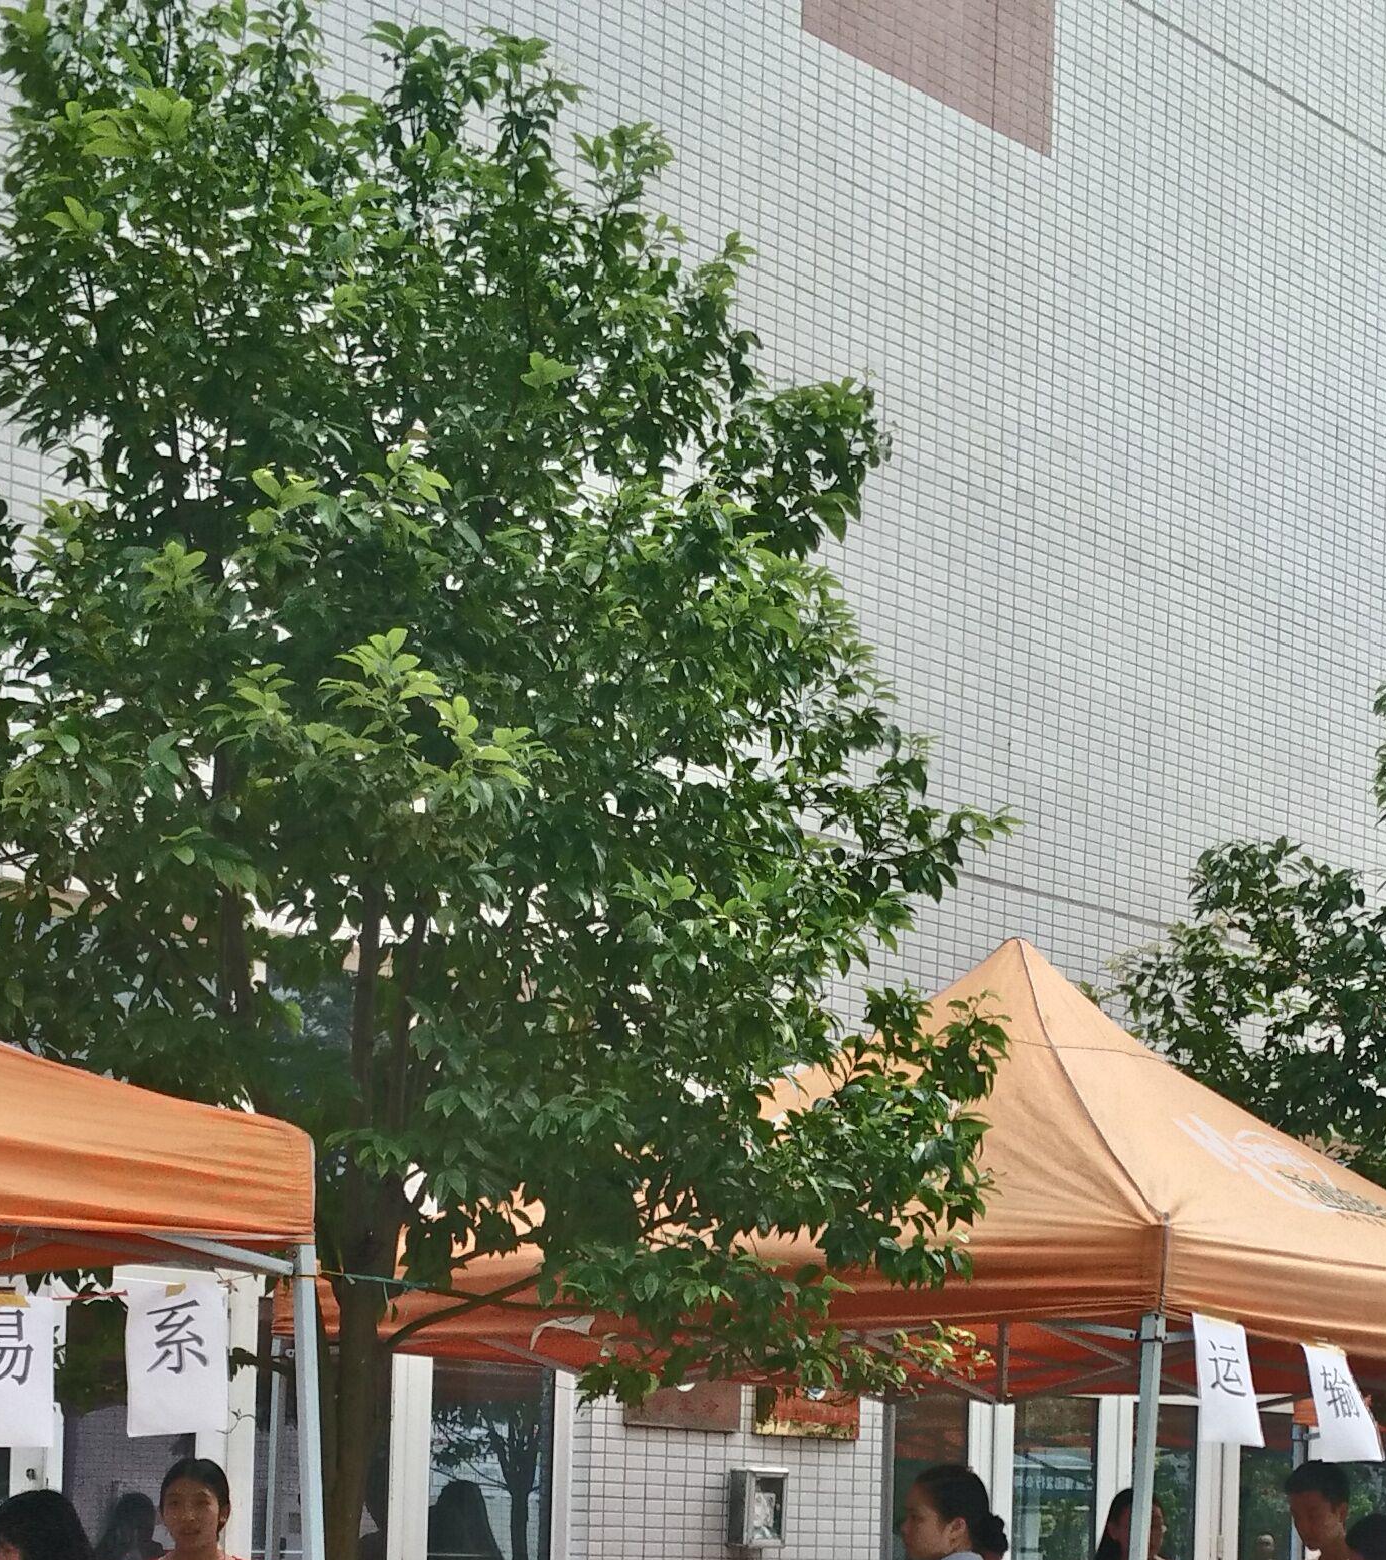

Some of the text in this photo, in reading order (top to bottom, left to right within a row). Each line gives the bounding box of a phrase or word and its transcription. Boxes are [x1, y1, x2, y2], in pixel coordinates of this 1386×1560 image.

[146, 1300, 209, 1375] 系
[1208, 1340, 1247, 1397] 运
[1320, 1365, 1361, 1419] 输
